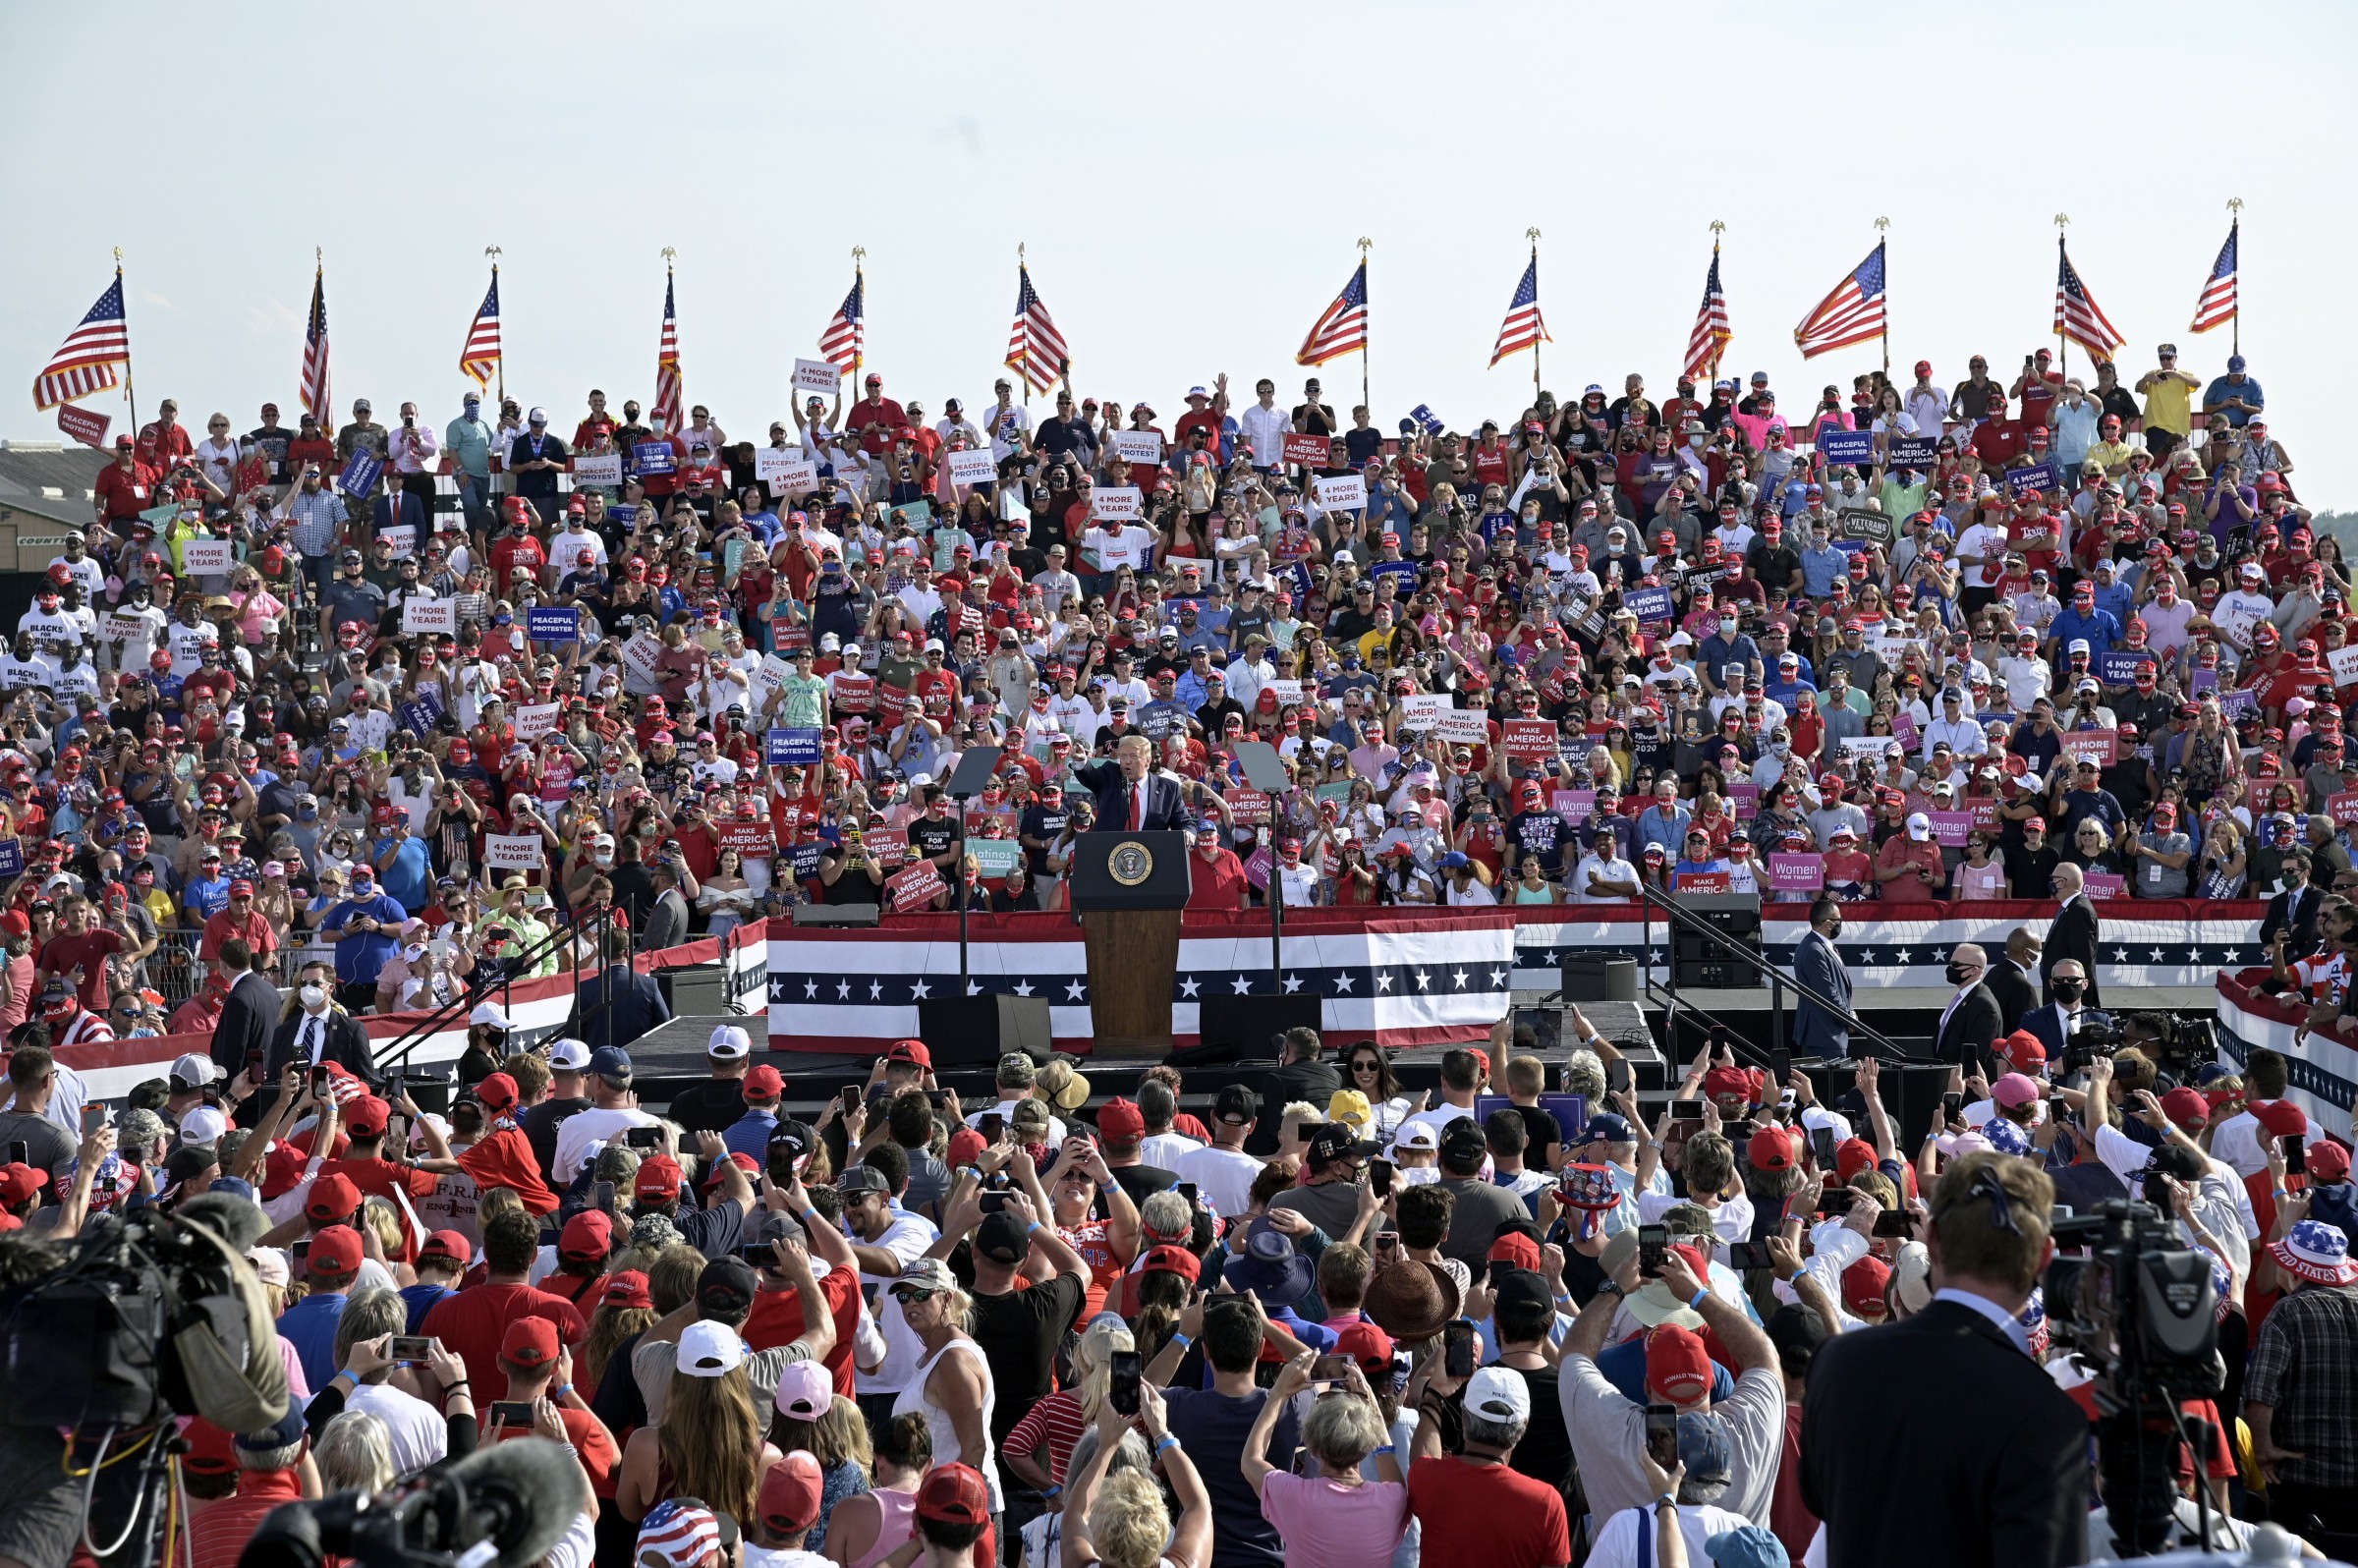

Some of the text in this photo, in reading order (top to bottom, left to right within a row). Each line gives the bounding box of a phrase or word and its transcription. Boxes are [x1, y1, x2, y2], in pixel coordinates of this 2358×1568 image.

[801, 375, 832, 386] YEARS!
[63, 414, 100, 431] PEACEFUL
[62, 421, 98, 438] PROTESTER
[1286, 444, 1326, 455] AMERICA
[1890, 448, 1934, 457] AMERICA
[347, 455, 368, 487] PEACEFUL
[784, 471, 809, 480] MORE
[955, 469, 990, 477] PROTEST
[2021, 472, 2049, 482] MORE
[777, 480, 811, 490] YEARS!
[2015, 480, 2050, 492] YEARS!
[1851, 518, 1886, 531] VETERANS
[1867, 526, 1882, 534] TRUMP
[1689, 574, 1712, 585] COPS
[1638, 595, 1665, 604] MORE
[1568, 607, 1581, 618] FOR
[1632, 604, 1665, 615] YEARS!
[115, 620, 141, 629] MORE
[105, 627, 140, 637] YEARS!
[7, 669, 38, 680] BLACKS
[531, 712, 553, 722] MORE
[1437, 720, 1484, 730] AMERICA
[772, 738, 815, 747] PEACEFUL
[1506, 734, 1553, 743] AMERICA
[1635, 744, 1656, 753] 2020
[2079, 741, 2109, 750] MORE
[1930, 820, 1966, 832] Women
[721, 835, 768, 844] AMERICA
[494, 852, 533, 861] YEARS!
[1775, 864, 1817, 874] Women
[901, 869, 923, 882] MAKE
[2208, 868, 2221, 888] MAKE
[894, 872, 938, 896] AMERICA
[897, 880, 942, 904] GREAT AGAIN
[90, 1190, 113, 1204] 2020
[2296, 1261, 2336, 1283] STATES
[1663, 1372, 1706, 1384] DONALD TRUMP
